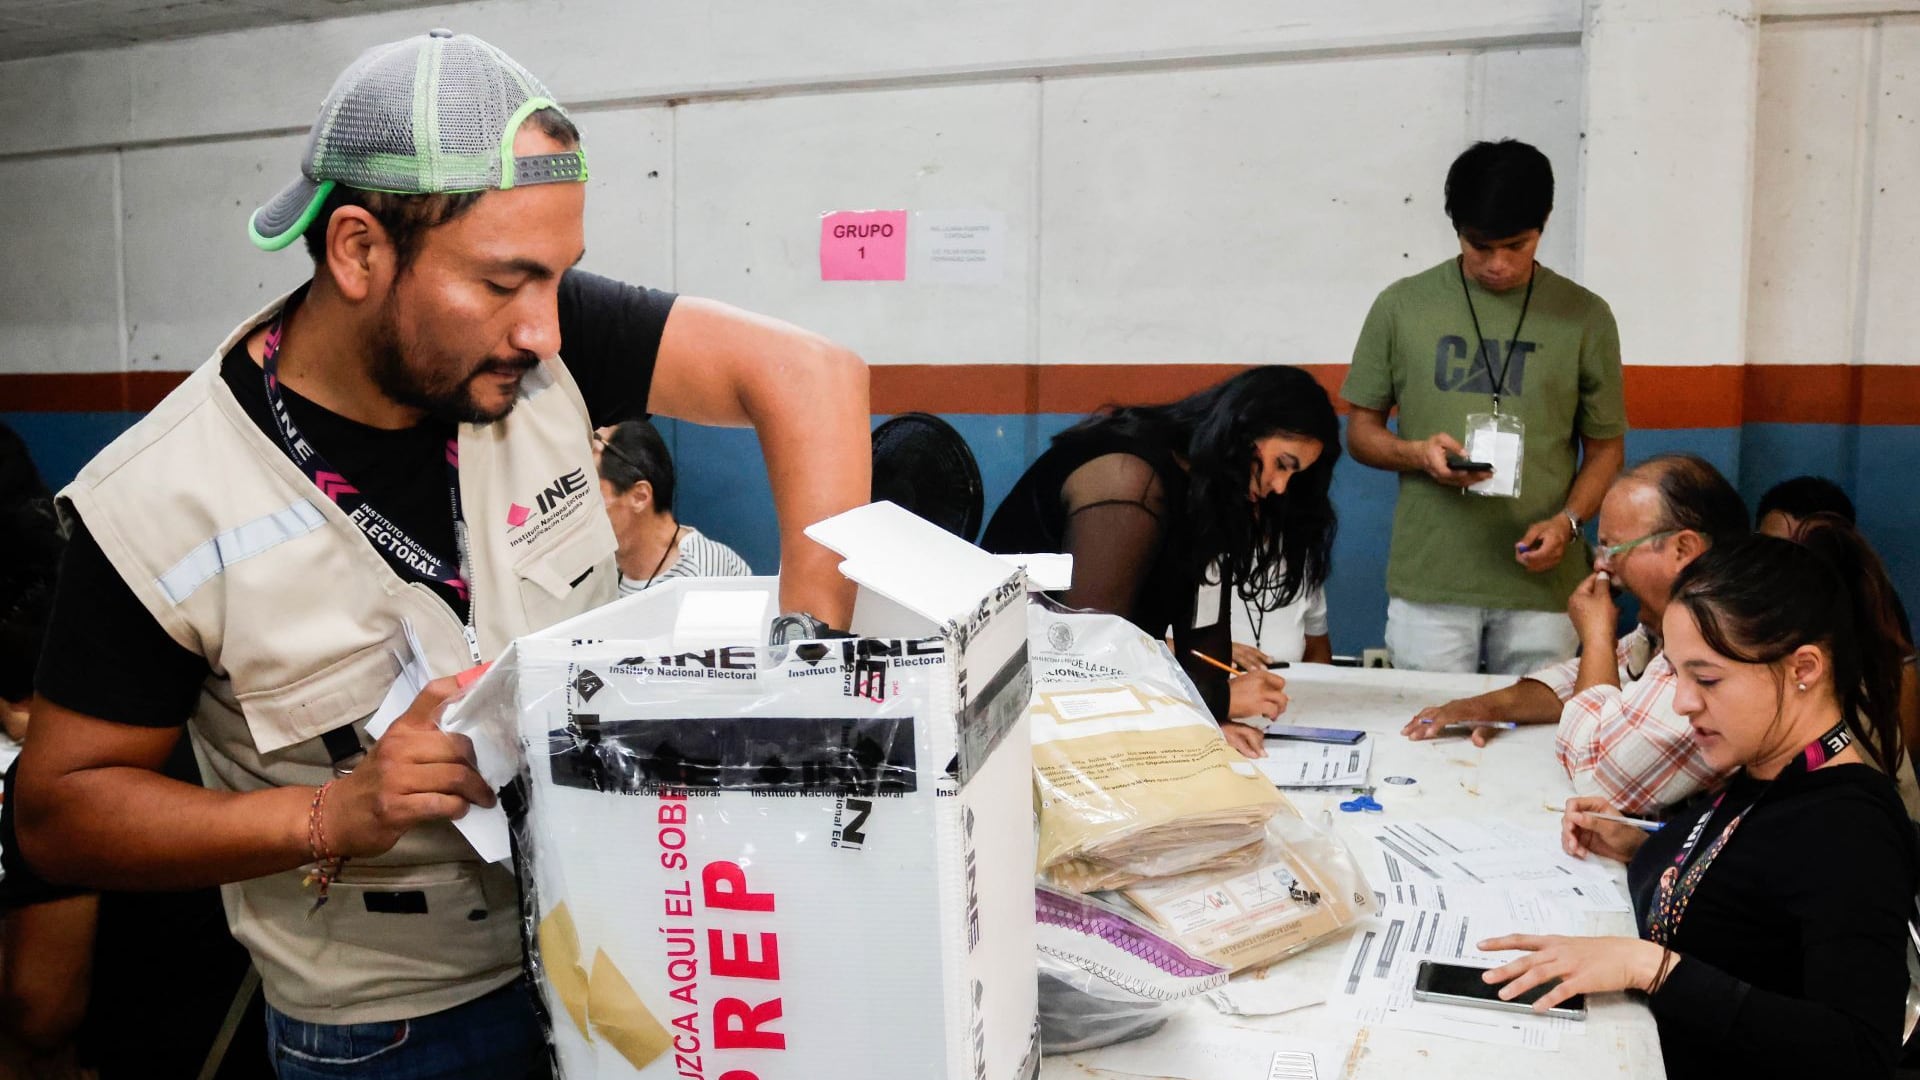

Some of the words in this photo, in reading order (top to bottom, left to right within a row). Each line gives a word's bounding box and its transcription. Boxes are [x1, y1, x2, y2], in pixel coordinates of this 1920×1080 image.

[833, 223, 894, 239] GRUPO
[857, 246, 866, 259] 1
[1434, 334, 1537, 397] CAT
[275, 398, 315, 462] INE
[535, 466, 588, 516] INE
[348, 508, 438, 578] ELECTORAL
[360, 502, 404, 538] INSTITUTO
[402, 535, 443, 568] NACIONAL
[510, 524, 540, 548] Instituto
[540, 505, 568, 527] Nacional
[608, 665, 655, 676] Instituto
[657, 666, 705, 679] Nacional
[706, 669, 758, 681] Electoral
[788, 667, 837, 678] Instituto
[893, 654, 946, 669] Electoral
[1827, 730, 1851, 753] NE
[751, 788, 797, 798] Instituto
[664, 880, 694, 917] EL
[658, 927, 699, 1006] AQUÍ
[701, 860, 787, 1080] REP
